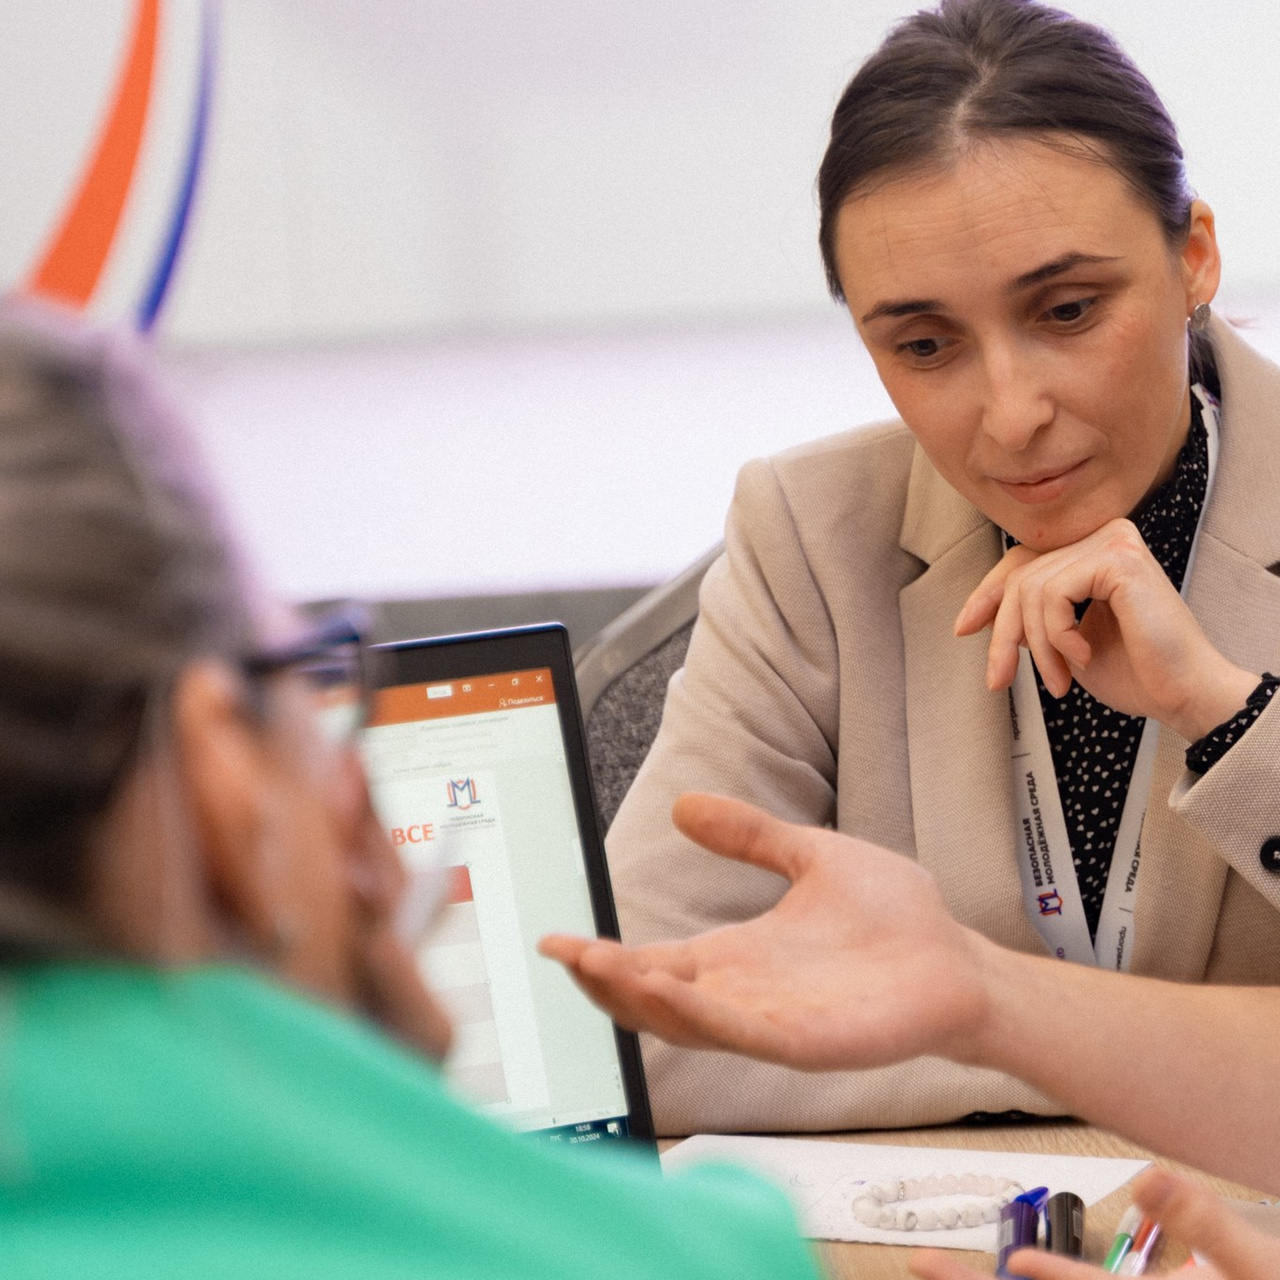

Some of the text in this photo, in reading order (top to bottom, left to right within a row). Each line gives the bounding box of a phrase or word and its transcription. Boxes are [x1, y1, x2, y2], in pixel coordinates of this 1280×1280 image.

[1022, 818, 1043, 887] БЕЗОПАСНАЯ
[1025, 771, 1055, 885] МОЛОДЁЖНАЯ СРЕДА
[1125, 859, 1140, 893] СРЕДА
